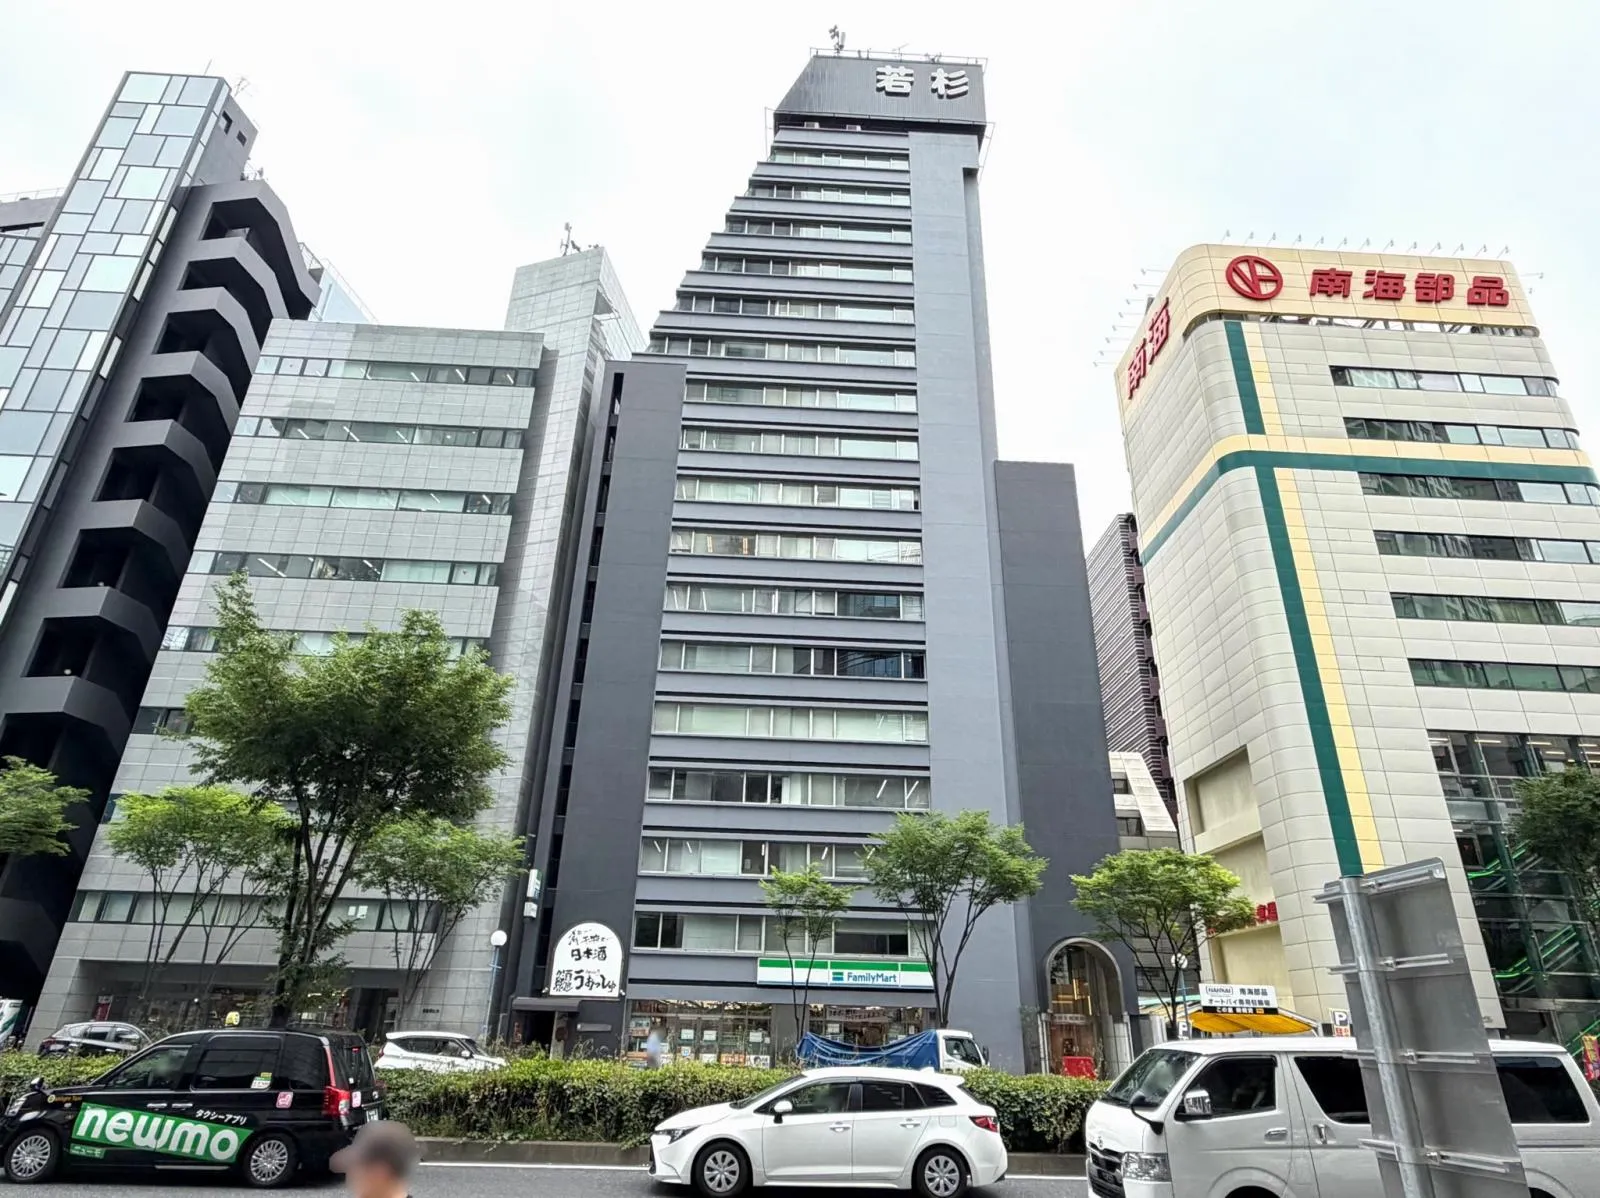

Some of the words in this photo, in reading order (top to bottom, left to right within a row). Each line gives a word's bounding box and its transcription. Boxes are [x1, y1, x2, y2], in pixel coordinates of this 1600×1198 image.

[875, 64, 969, 99] 若杉
[1309, 268, 1509, 306] 南海部品
[1127, 296, 1170, 400] 南海
[571, 945, 607, 962] 日本酒
[847, 972, 897, 983] FamilyMart
[1334, 1011, 1347, 1026] P
[1179, 1021, 1188, 1036] P
[196, 1109, 247, 1125] タクシーアプリ
[76, 1106, 239, 1160] newmo
